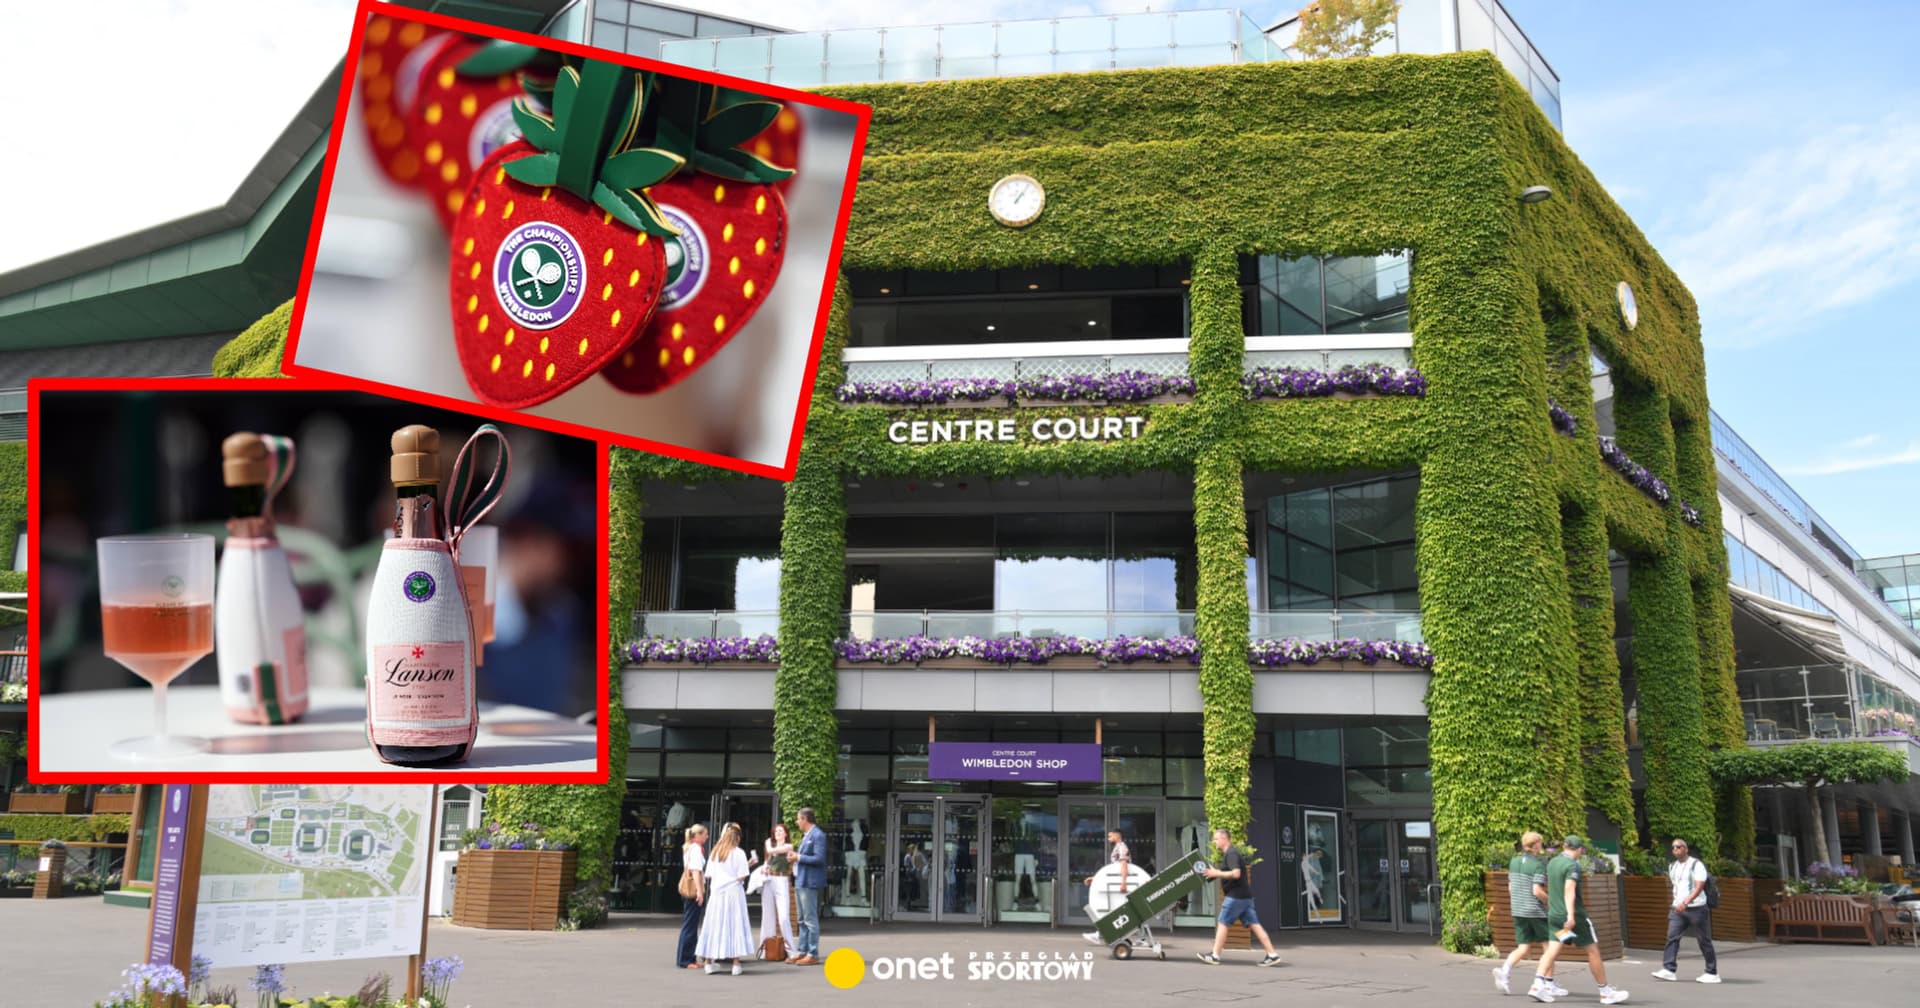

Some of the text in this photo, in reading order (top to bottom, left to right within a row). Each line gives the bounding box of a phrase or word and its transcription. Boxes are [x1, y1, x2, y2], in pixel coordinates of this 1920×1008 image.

[505, 228, 580, 296] THE CHAMPIONSHIPS
[499, 281, 553, 323] WIMBLEDON
[889, 416, 1143, 443] CENTRE COURT
[385, 657, 456, 687] Lanson
[962, 758, 1068, 769] WIMBLEDON SHOP
[1146, 869, 1194, 903] PHONE CHARGERS
